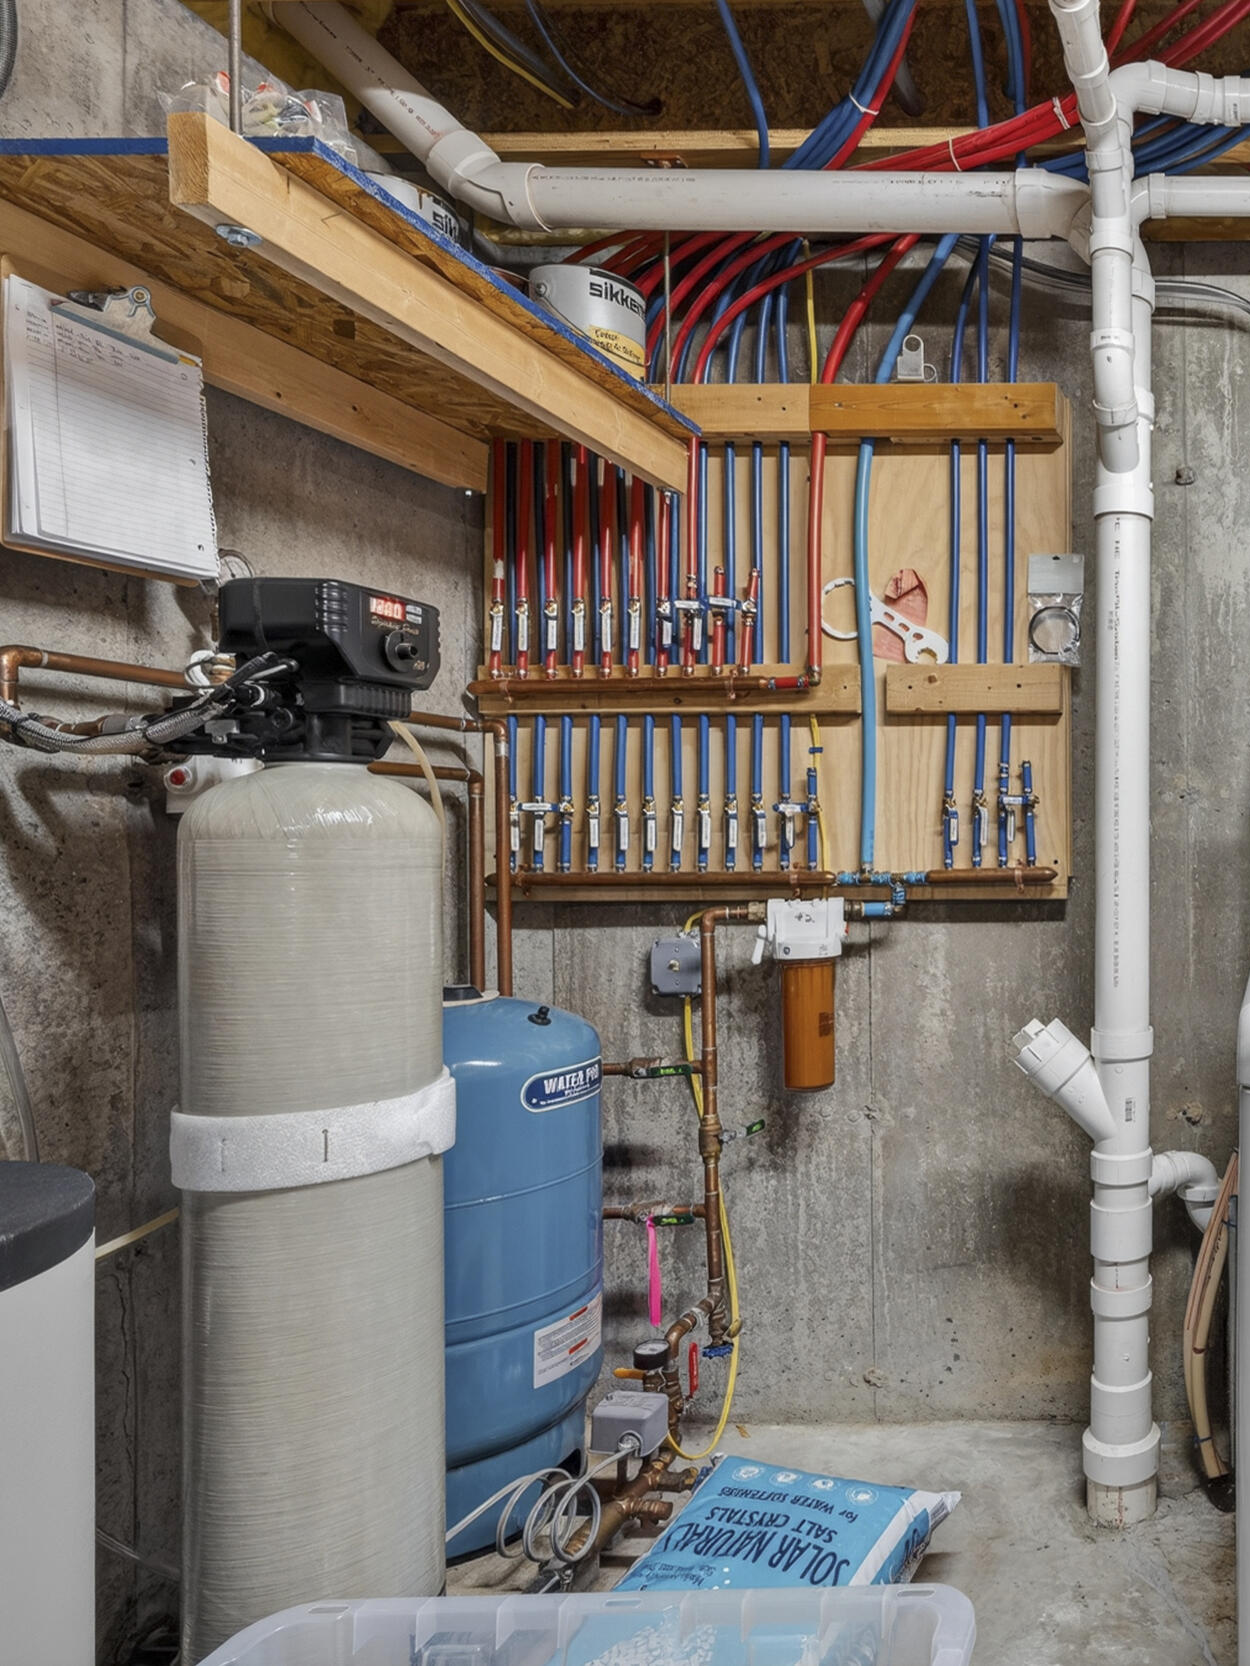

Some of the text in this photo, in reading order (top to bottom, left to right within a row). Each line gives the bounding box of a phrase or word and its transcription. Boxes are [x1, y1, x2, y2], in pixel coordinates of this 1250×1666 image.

[790, 1494, 834, 1515] WATER
[838, 1509, 860, 1524] for
[705, 1506, 838, 1543] SALT CRYSTALS
[768, 1534, 851, 1587] SOLAR
